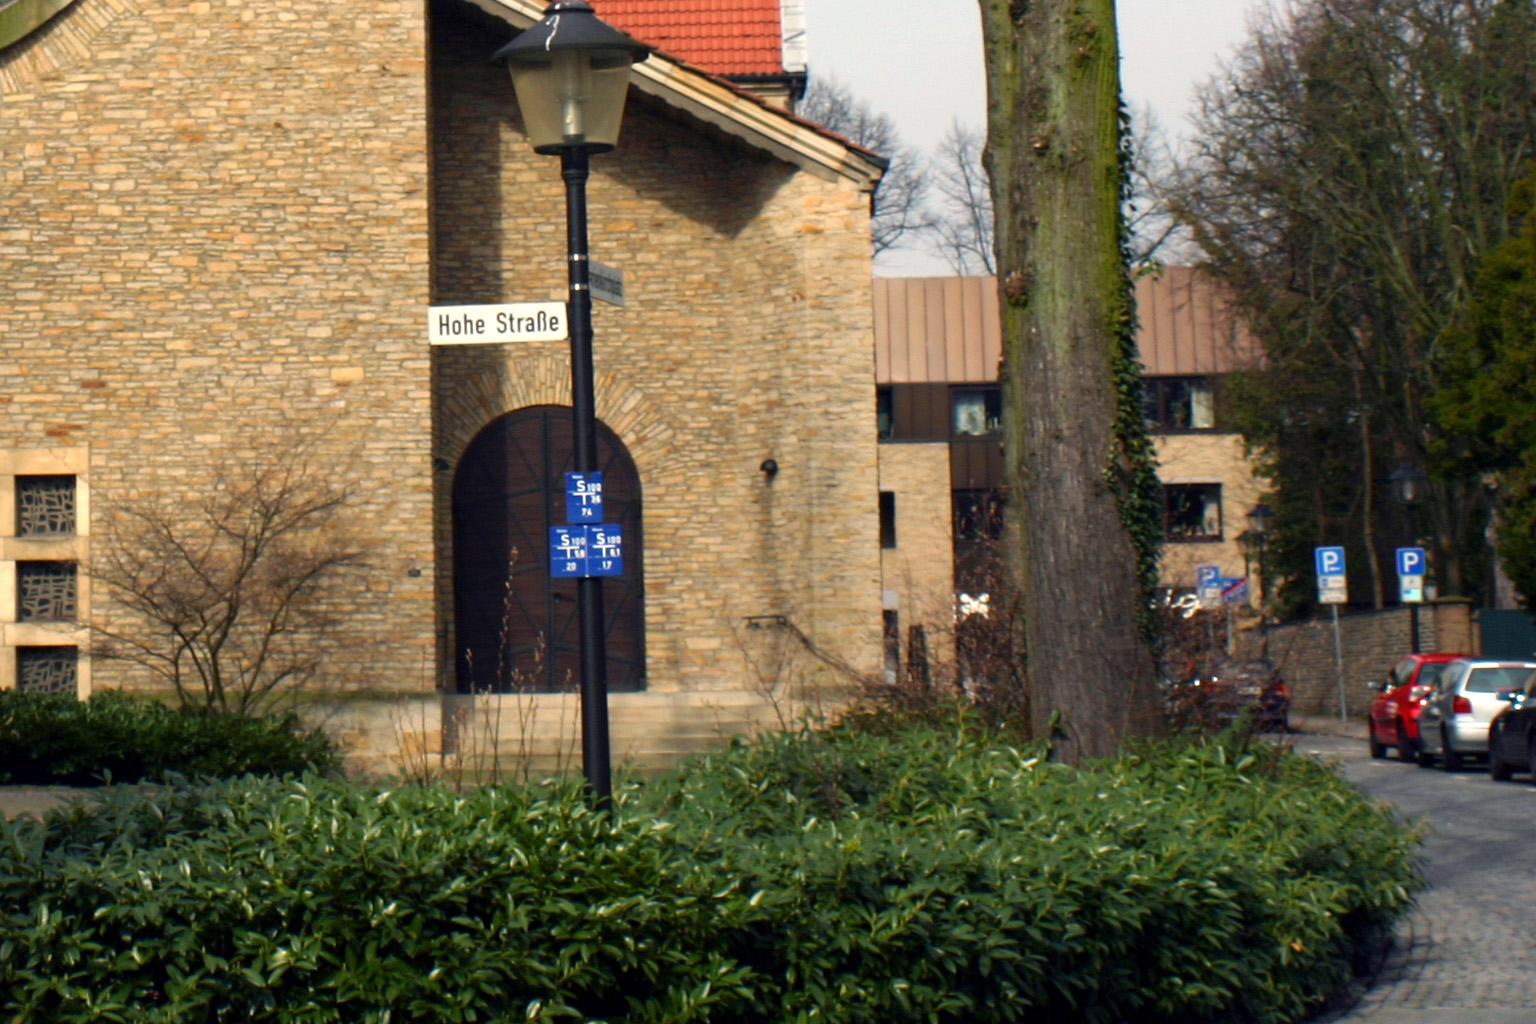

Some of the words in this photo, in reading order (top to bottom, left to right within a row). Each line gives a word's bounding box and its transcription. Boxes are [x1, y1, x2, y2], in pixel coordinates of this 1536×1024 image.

[439, 313, 485, 336] Hohe
[496, 310, 559, 334] Straße
[1322, 550, 1339, 573] P
[1403, 551, 1419, 573] P
